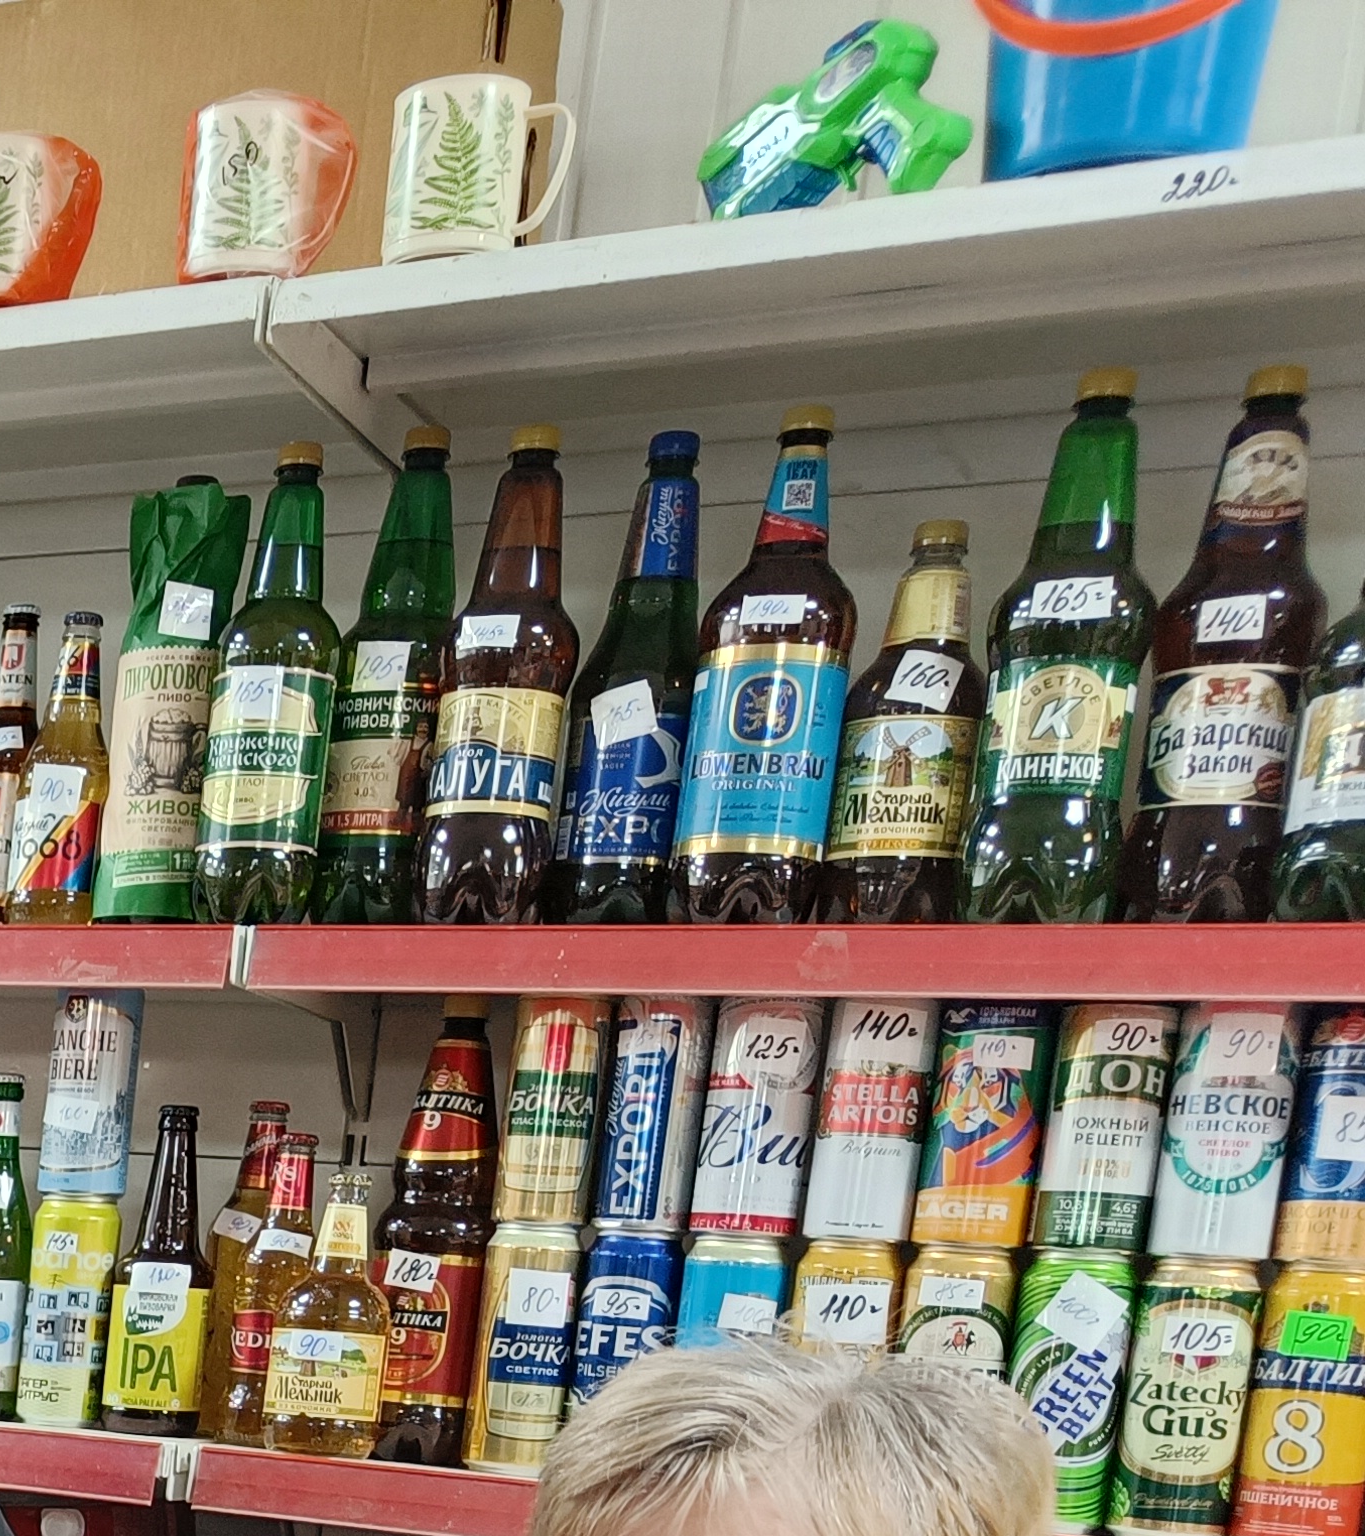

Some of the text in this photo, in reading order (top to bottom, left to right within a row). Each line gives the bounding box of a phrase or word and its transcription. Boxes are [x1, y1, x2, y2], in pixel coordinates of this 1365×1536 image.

[157, 694, 192, 702] ПИВО
[1021, 674, 1103, 708] СВЕТЛОЕ
[343, 713, 410, 729] ПИВОВАР
[458, 748, 484, 758] МОЯ
[996, 754, 1104, 782] КЛИНСКОЕ
[711, 779, 796, 792] ORIGINAL
[872, 790, 931, 806] Старый
[352, 812, 383, 827] ЛИТРА
[844, 793, 946, 826] Мельник
[1065, 1058, 1166, 1099] ДОН
[509, 1090, 594, 1116] БОЧКА
[831, 1083, 919, 1105] STELLA
[827, 1104, 918, 1126] ARTOIS
[1171, 1094, 1292, 1119] НЕВСКОЕ
[422, 1111, 442, 1131] 9
[1071, 1115, 1150, 1135] ЮЖНЫЙ
[1184, 1119, 1270, 1135] ВЕНСКОЕ
[610, 1048, 661, 1217] EXPORT
[1073, 1132, 1145, 1148] РЕЦЕПТ
[838, 1141, 902, 1158] Belgium
[915, 1202, 1009, 1221] LAGER
[515, 1333, 562, 1343] ЗОЛОТАЯ
[489, 1337, 570, 1365] БОЧКА
[119, 1337, 178, 1393] IPA
[505, 1366, 559, 1377] СВЕТЛОЕ
[274, 1375, 343, 1405] Мельник
[291, 1375, 332, 1390] Старый
[1130, 1367, 1247, 1414] Žatecký
[1057, 1373, 1114, 1441] BEAT
[1142, 1404, 1228, 1441] Gus
[1263, 1400, 1325, 1475] 8
[1240, 1490, 1339, 1511] ПШЕНИЧНОЕ
